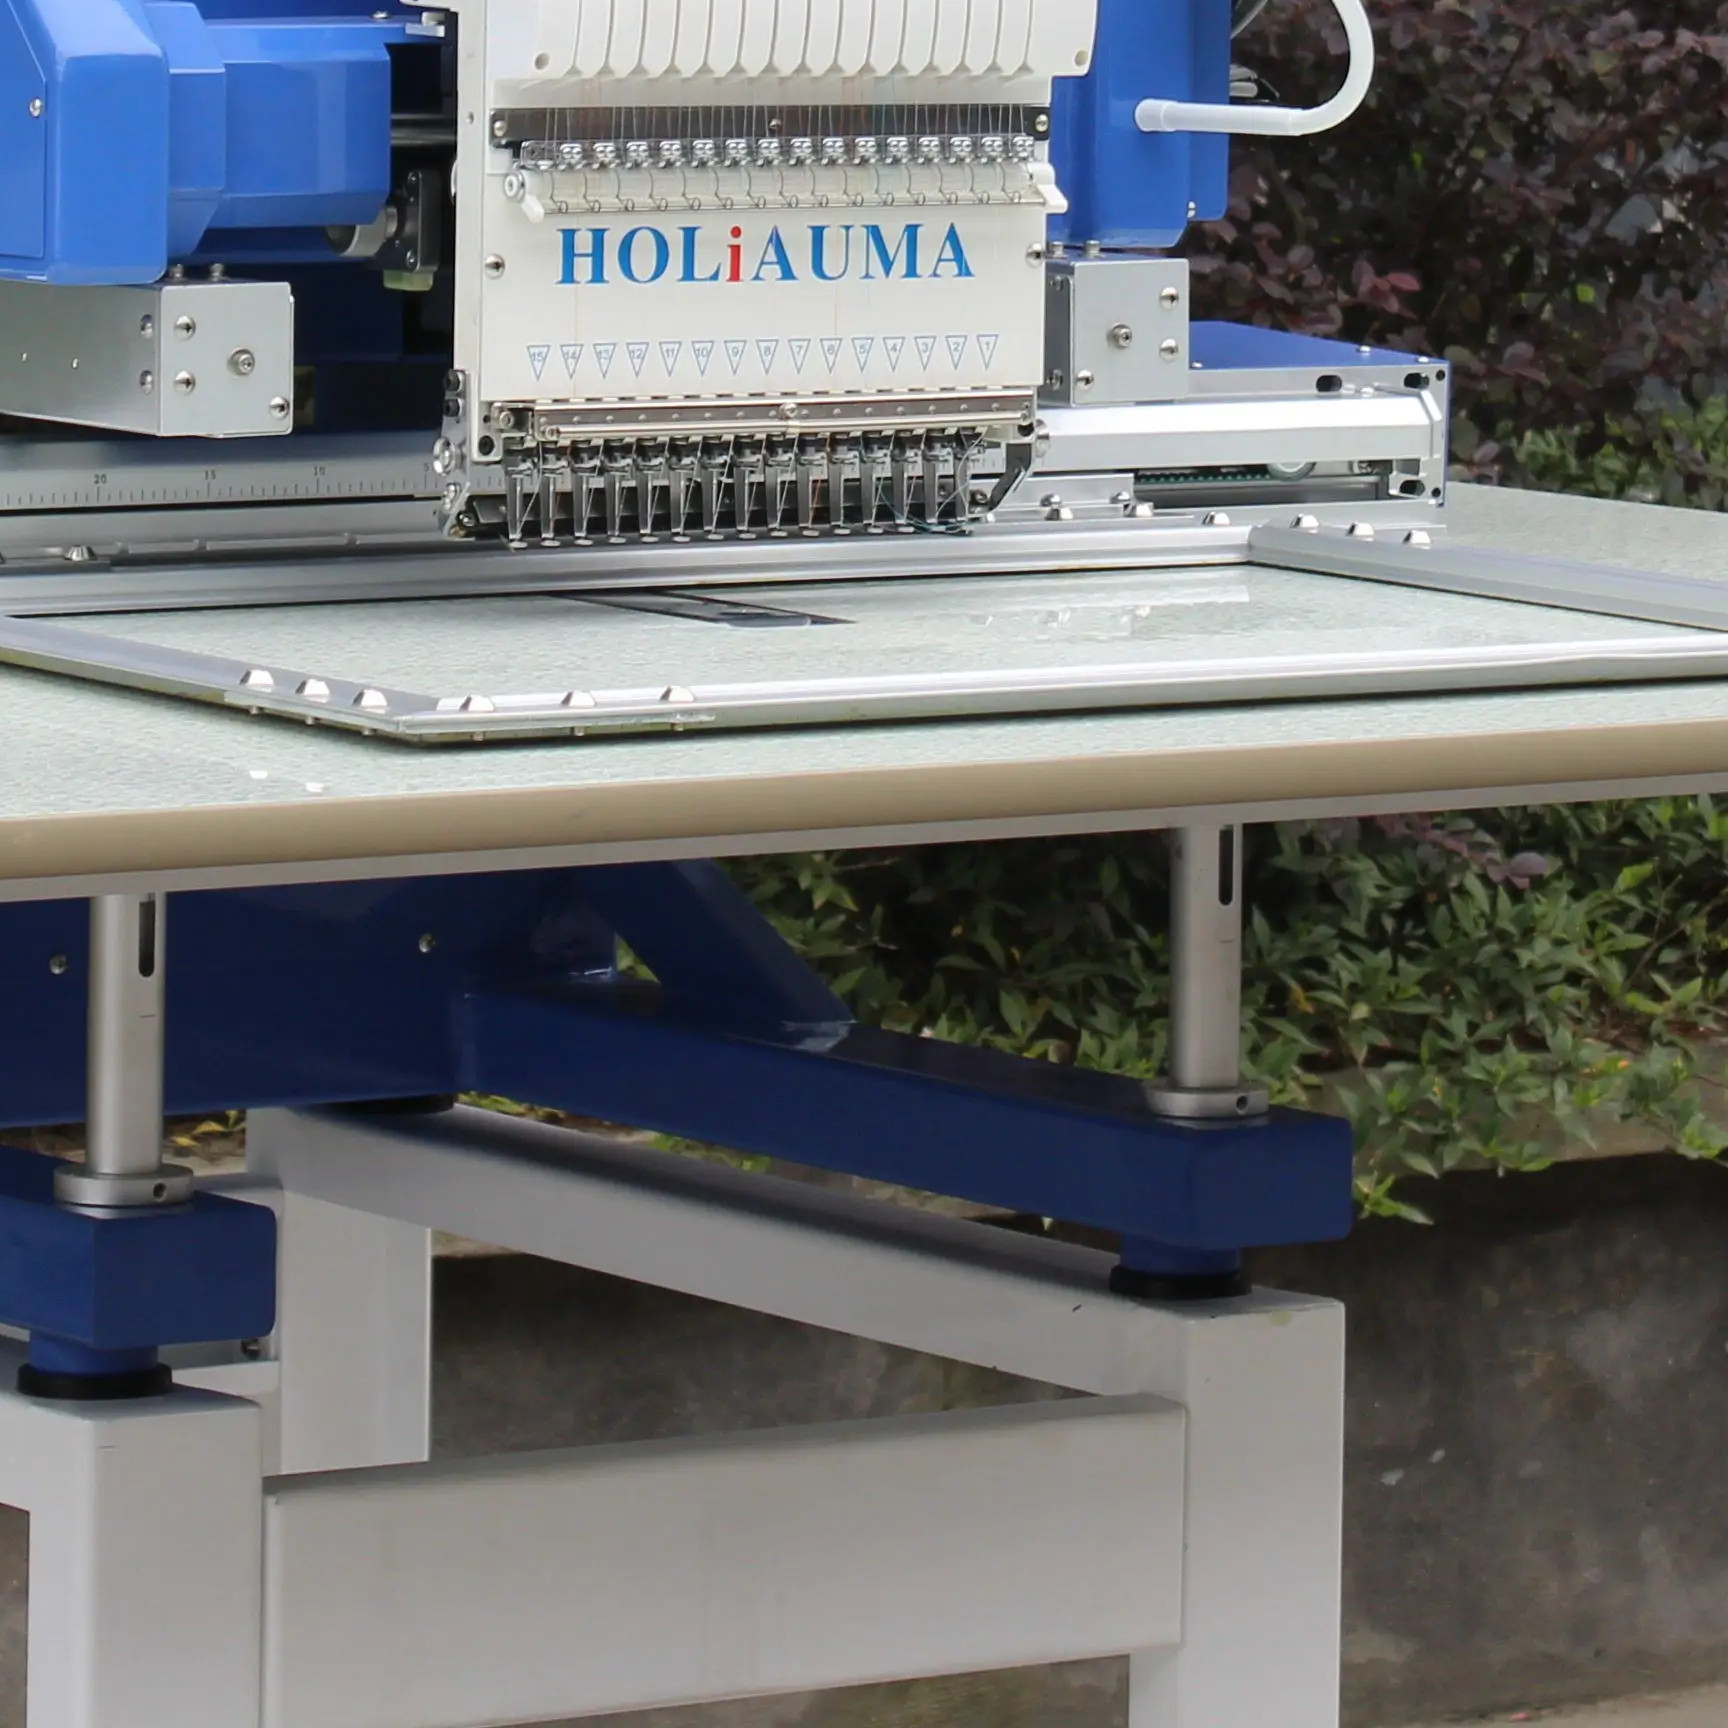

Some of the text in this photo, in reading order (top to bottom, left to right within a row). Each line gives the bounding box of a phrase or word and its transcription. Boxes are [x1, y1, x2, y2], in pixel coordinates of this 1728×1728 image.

[556, 222, 976, 286] HOLiAUMA
[530, 341, 990, 363] 15 14 13 12 11 10 9 8 7 6 5 4 3 2 1
[93, 474, 108, 485] 20
[204, 470, 217, 480] 15
[313, 466, 326, 476] 10
